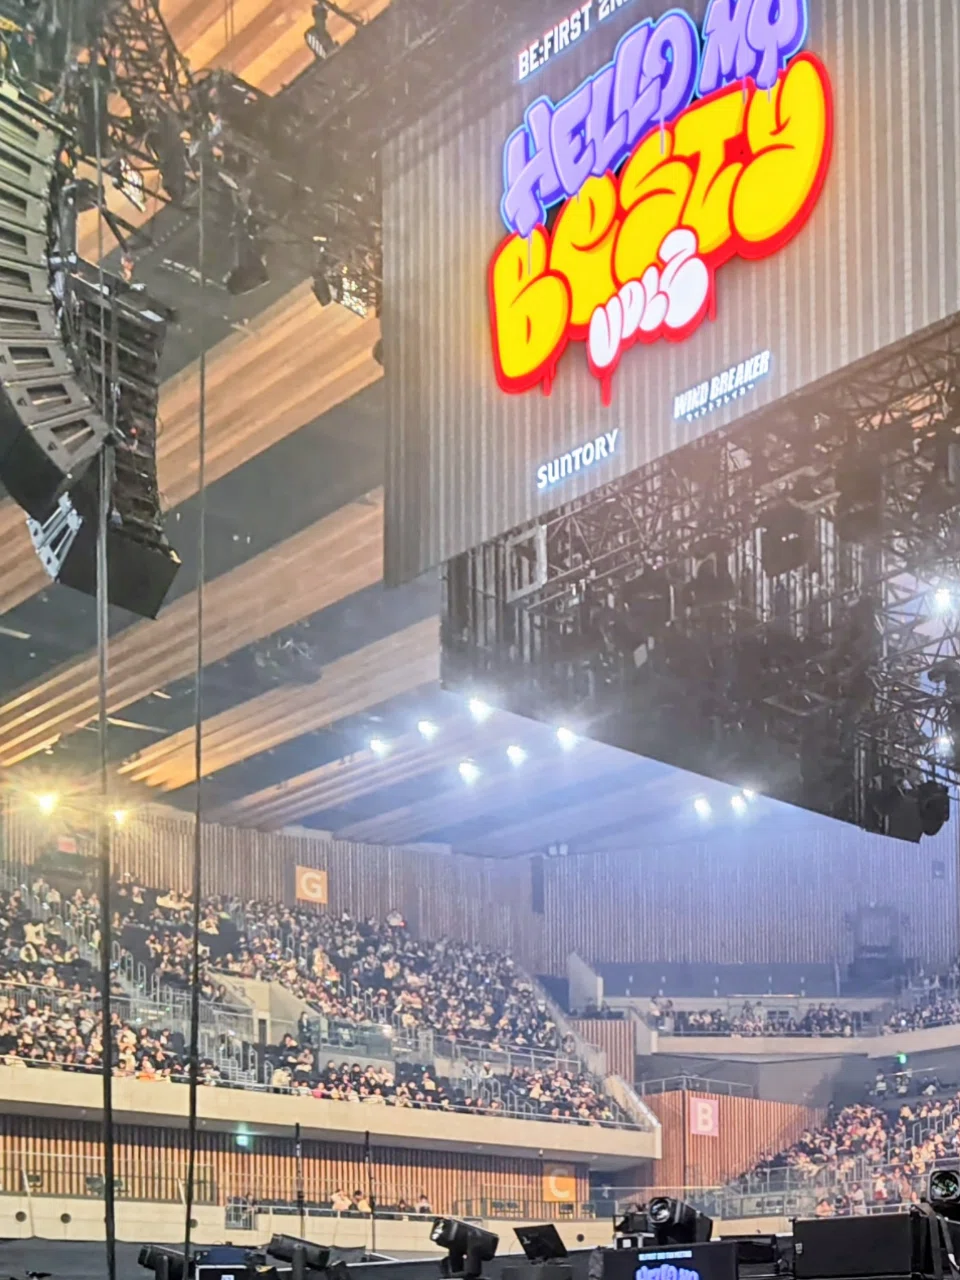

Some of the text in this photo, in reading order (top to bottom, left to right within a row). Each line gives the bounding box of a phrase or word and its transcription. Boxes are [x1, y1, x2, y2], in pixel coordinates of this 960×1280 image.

[517, 1, 592, 81] BE:FIRST
[501, 8, 701, 238] HELLO
[709, 350, 770, 401] BREAKER
[536, 428, 619, 489] SUNTORY
[302, 871, 323, 898] G
[696, 1102, 713, 1131] B
[549, 1169, 569, 1199] C
